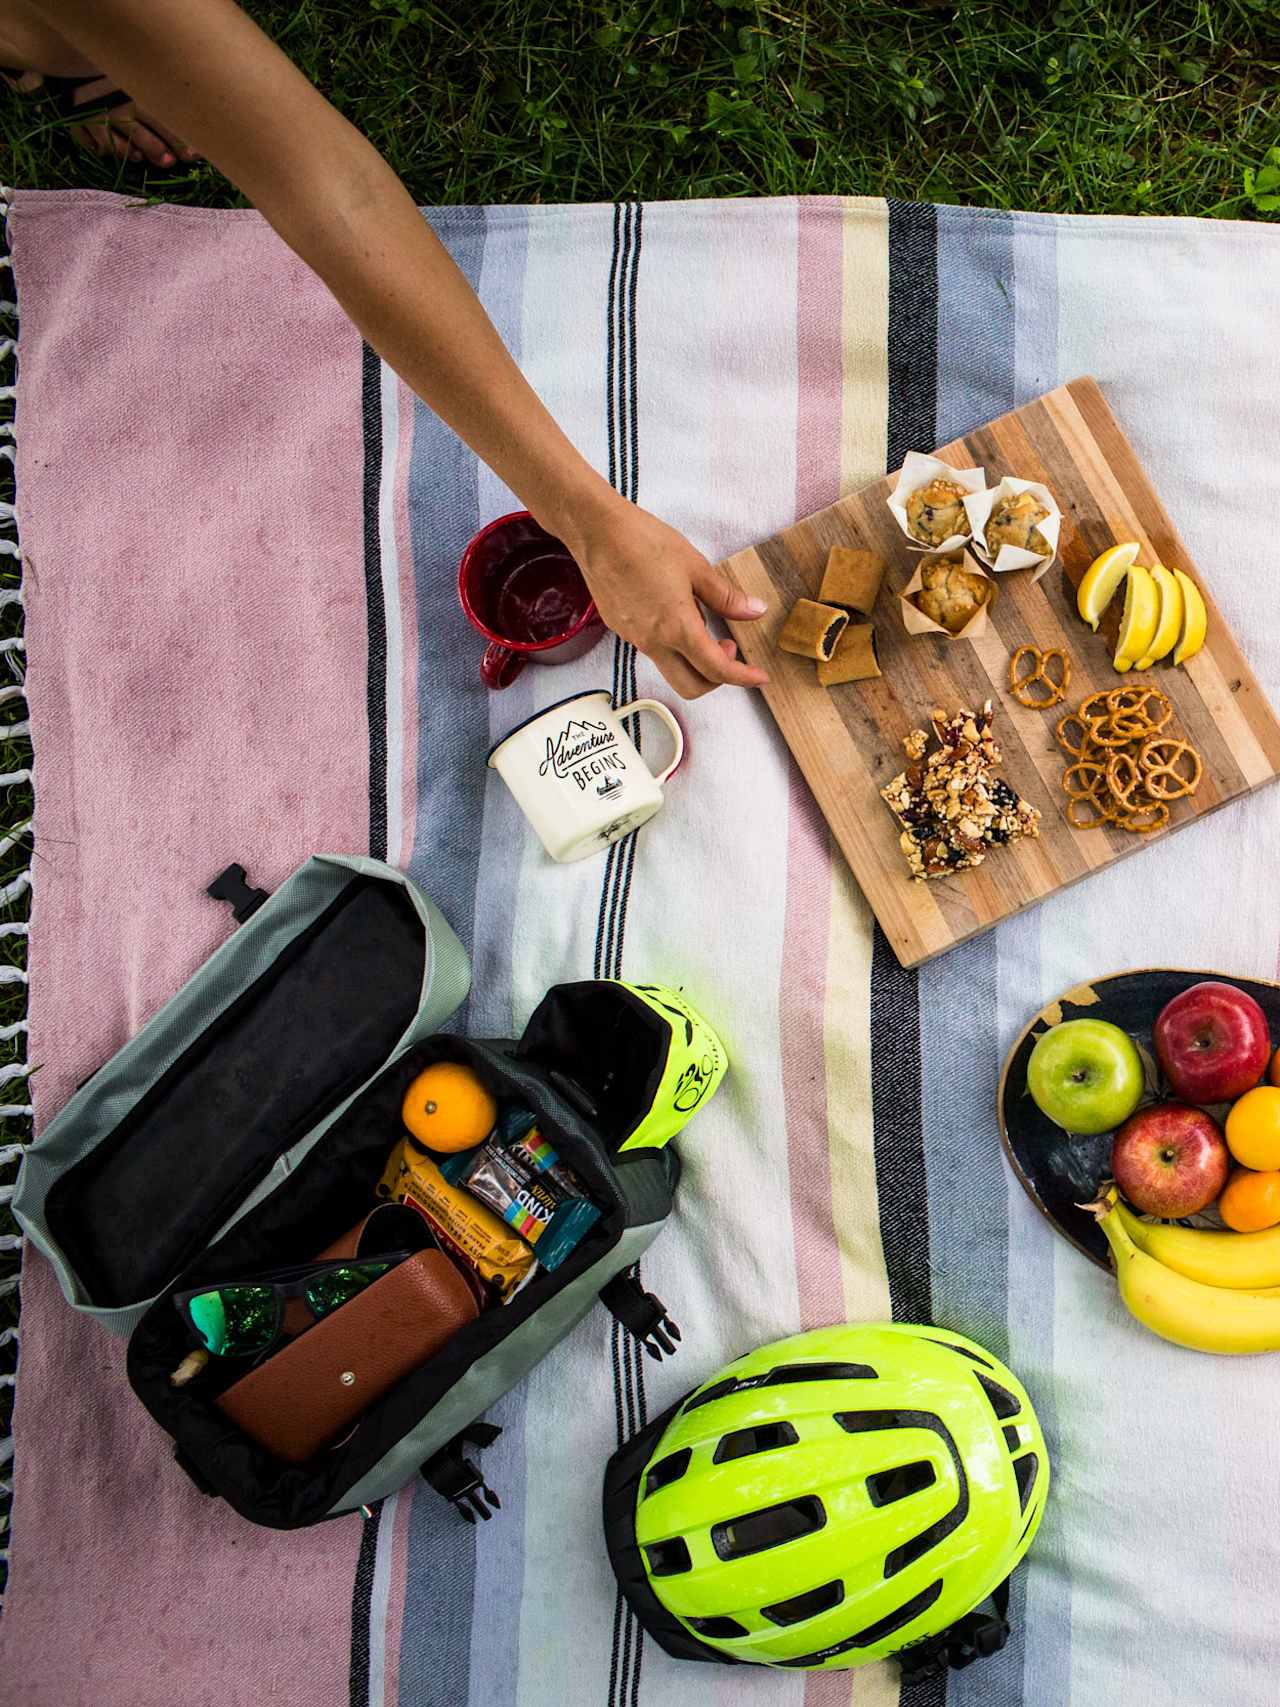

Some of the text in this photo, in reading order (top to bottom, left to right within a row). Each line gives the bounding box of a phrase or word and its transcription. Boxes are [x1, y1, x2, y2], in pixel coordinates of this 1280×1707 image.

[539, 731, 615, 778] Adventure
[571, 732, 585, 742] THE
[572, 752, 627, 791] BEGINS
[517, 1190, 555, 1225] KIND
